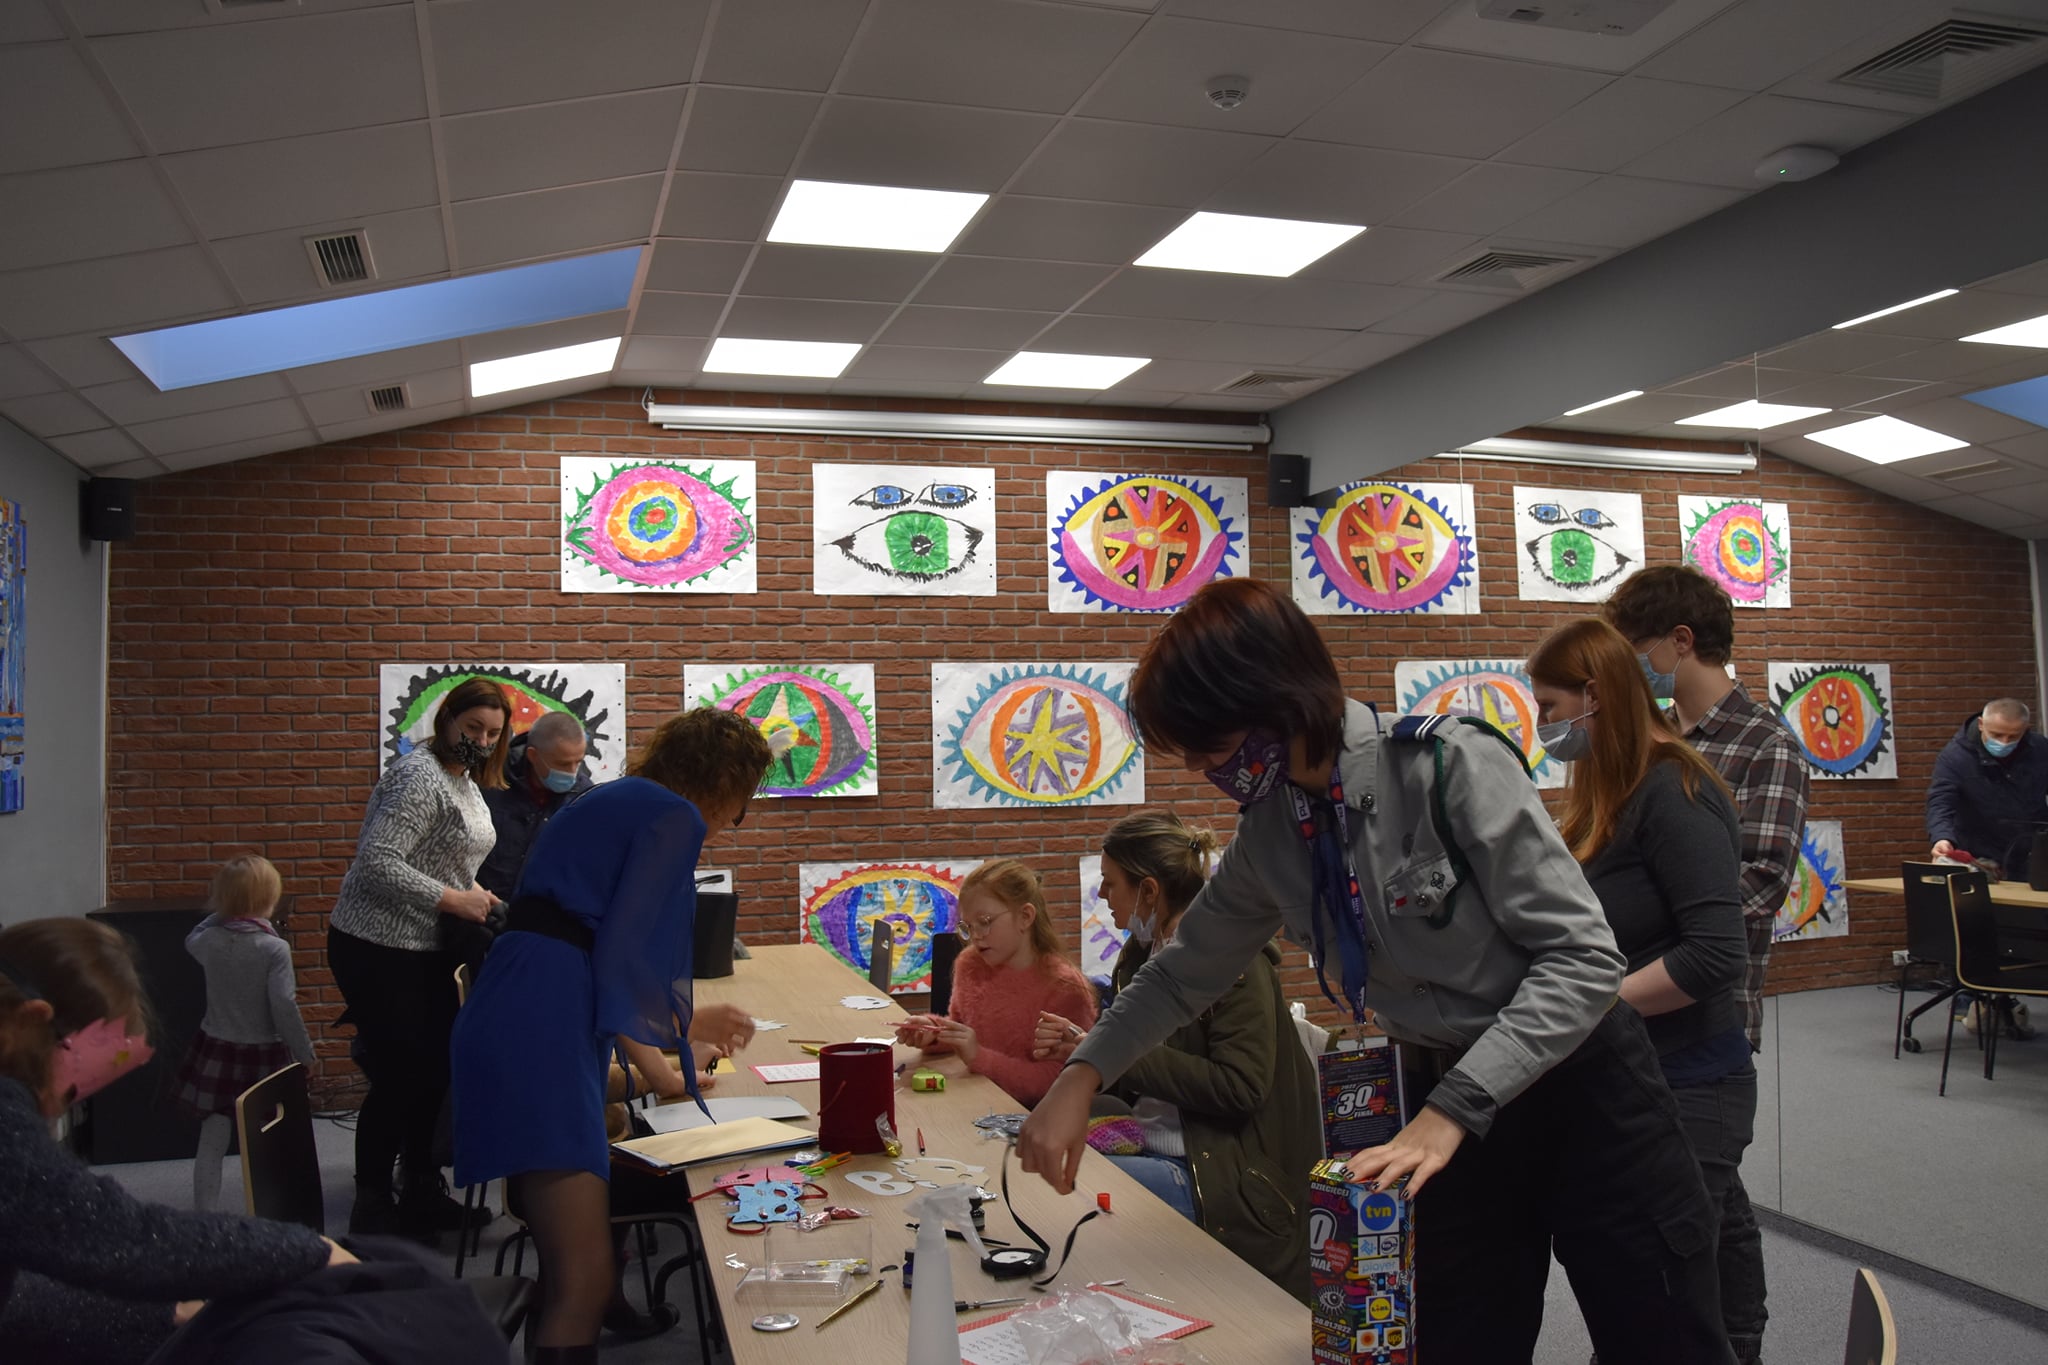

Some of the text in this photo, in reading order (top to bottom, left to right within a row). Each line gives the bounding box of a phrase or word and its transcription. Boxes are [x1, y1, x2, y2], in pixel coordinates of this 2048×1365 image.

[1235, 767, 1253, 794] 30
[1336, 1084, 1374, 1116] 30
[1365, 1205, 1392, 1218] tvn
[1362, 1261, 1395, 1273] player
